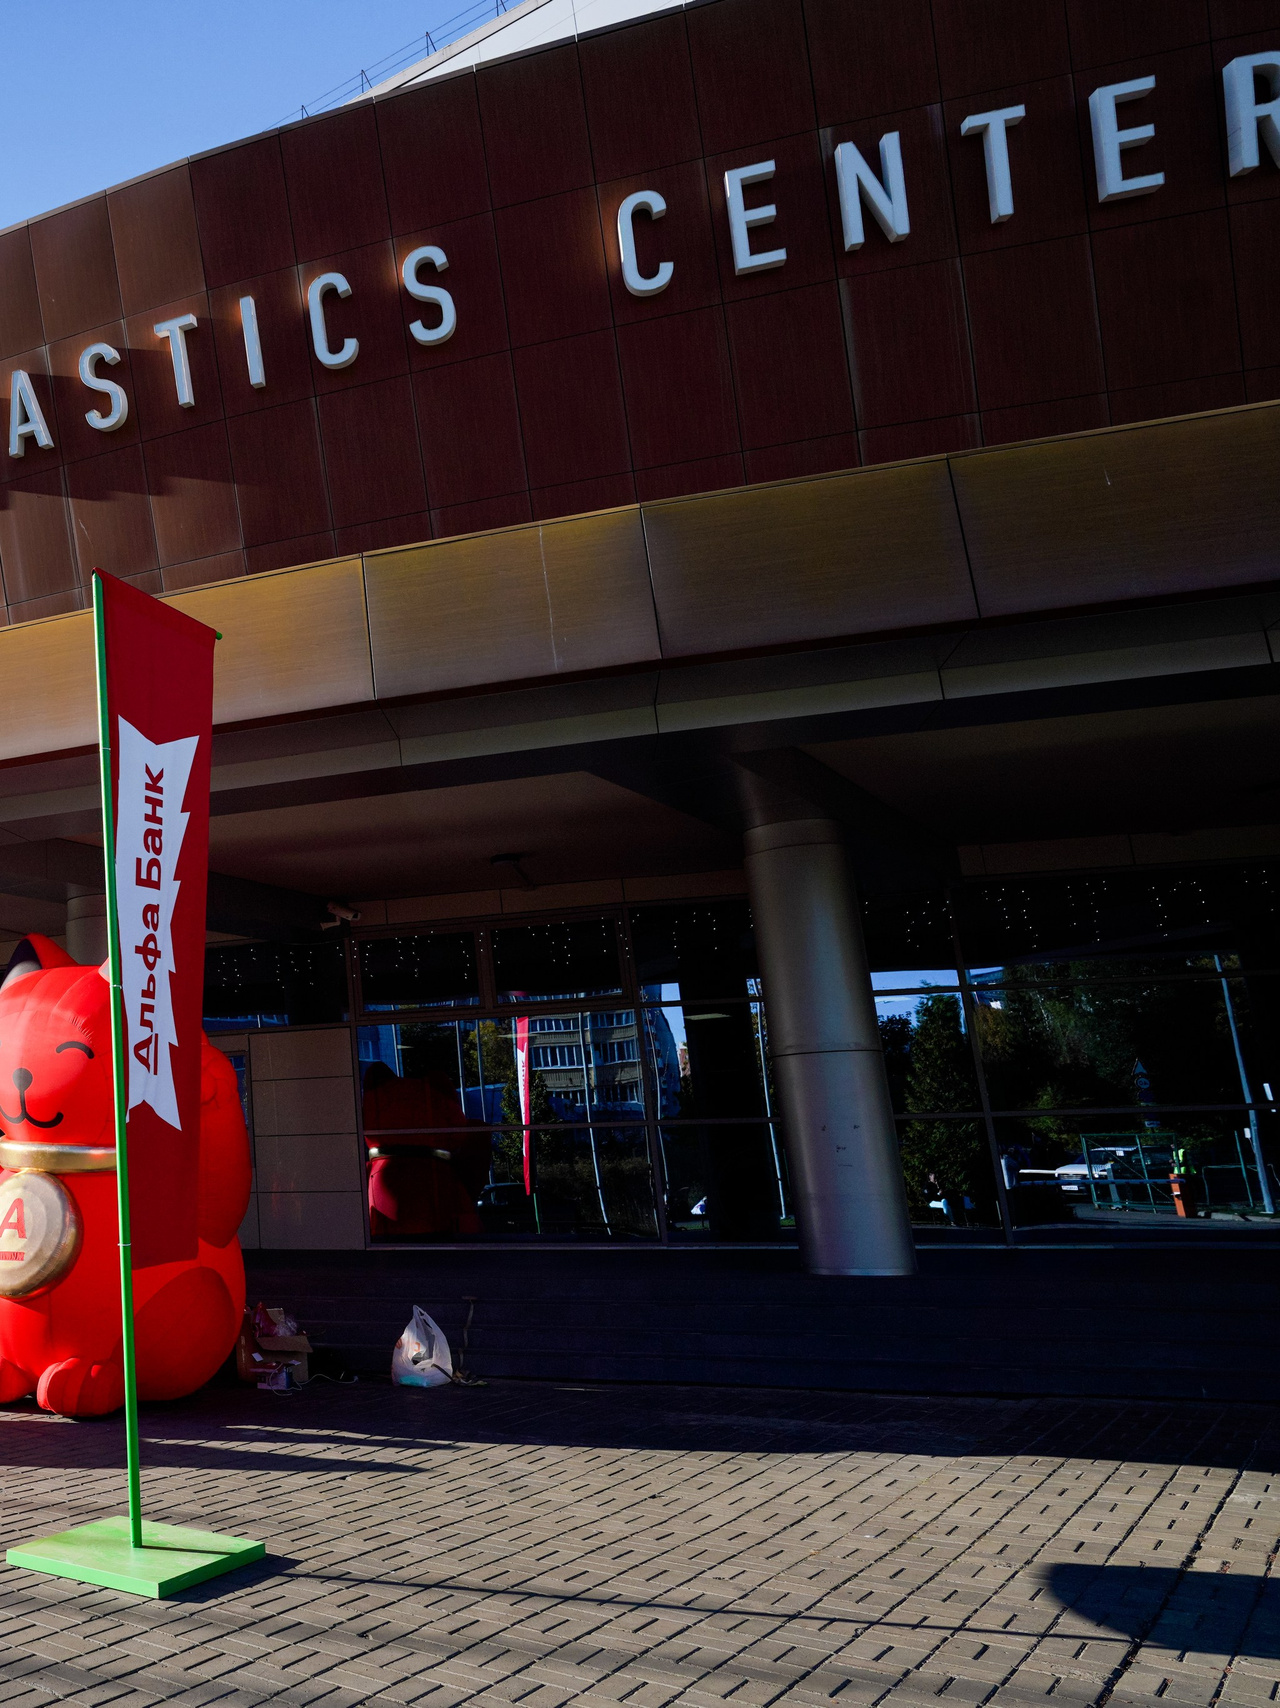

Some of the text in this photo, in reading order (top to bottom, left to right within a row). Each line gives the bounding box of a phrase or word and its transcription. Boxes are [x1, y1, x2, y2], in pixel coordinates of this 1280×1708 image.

[617, 51, 1280, 297] CENTER
[134, 762, 164, 1076] Альфа Банк
